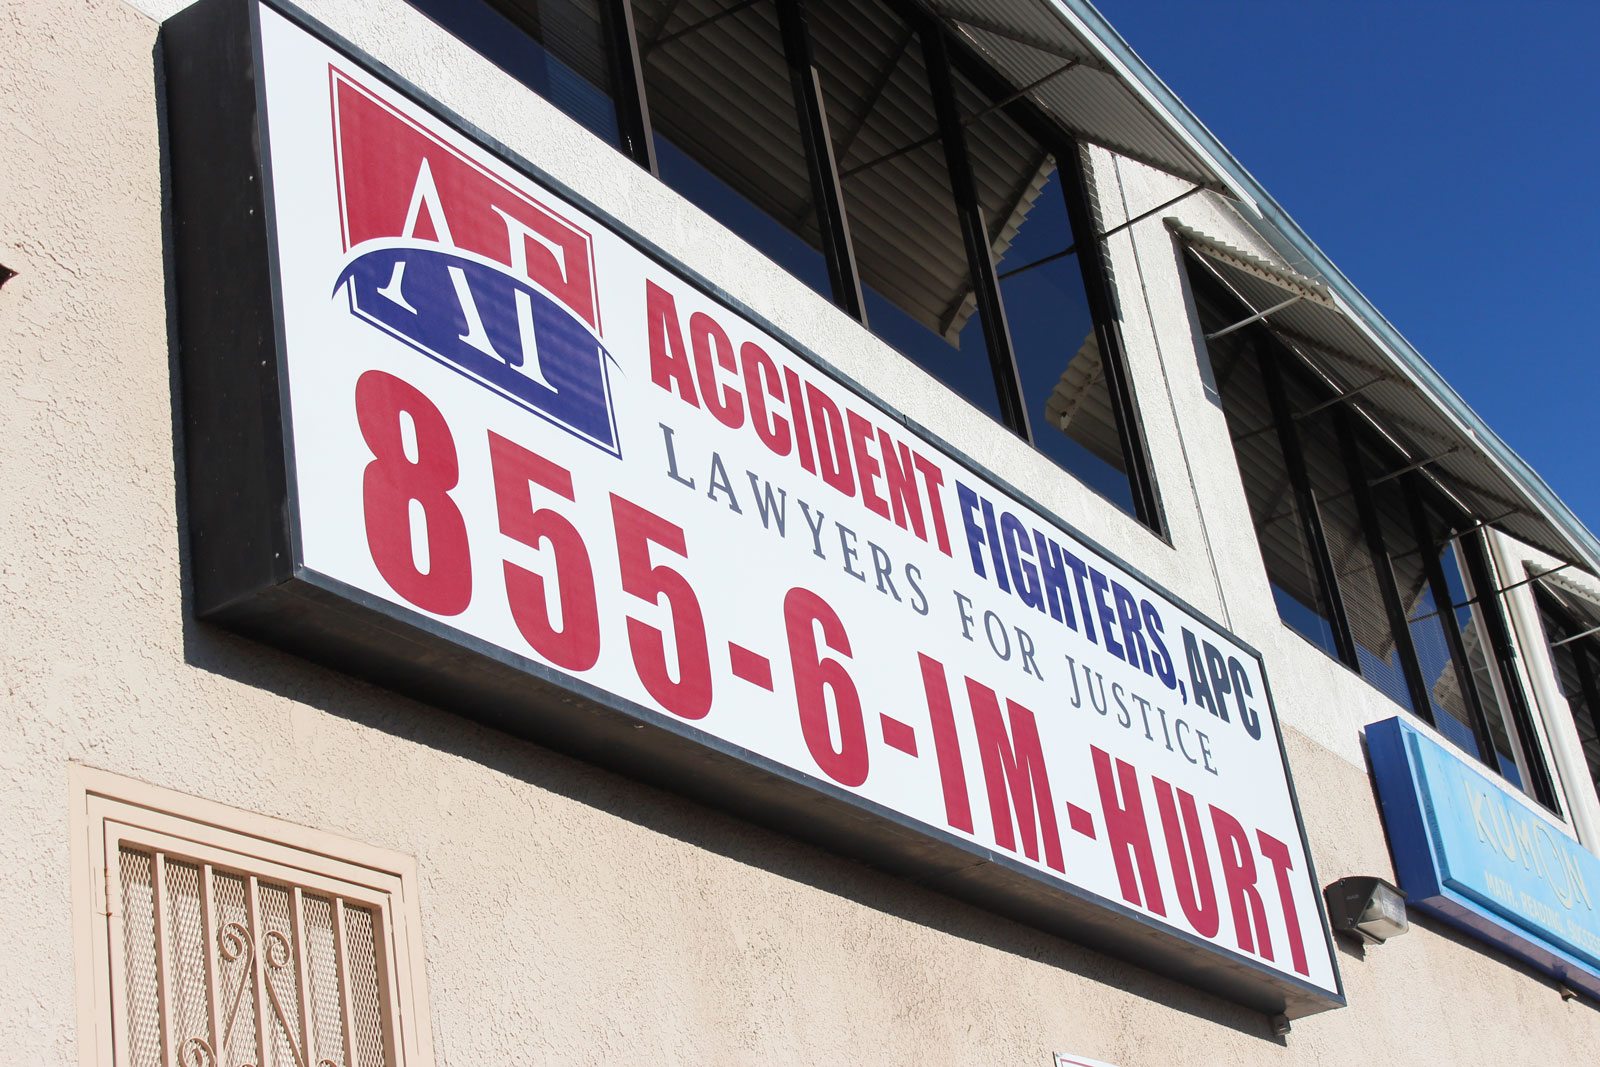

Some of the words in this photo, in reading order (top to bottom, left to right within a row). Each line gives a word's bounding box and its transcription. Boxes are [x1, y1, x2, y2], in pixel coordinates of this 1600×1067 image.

[355, 370, 1310, 978] 855-6-IM-HURT
[646, 278, 952, 558] ACCIDENT
[956, 479, 1187, 704] FIGHTERS,
[1181, 626, 1261, 740] APC
[659, 422, 928, 615] LAWYERS
[953, 590, 1043, 681] FOR
[1065, 655, 1218, 775] JUSTICE
[1464, 780, 1592, 911] KUMON
